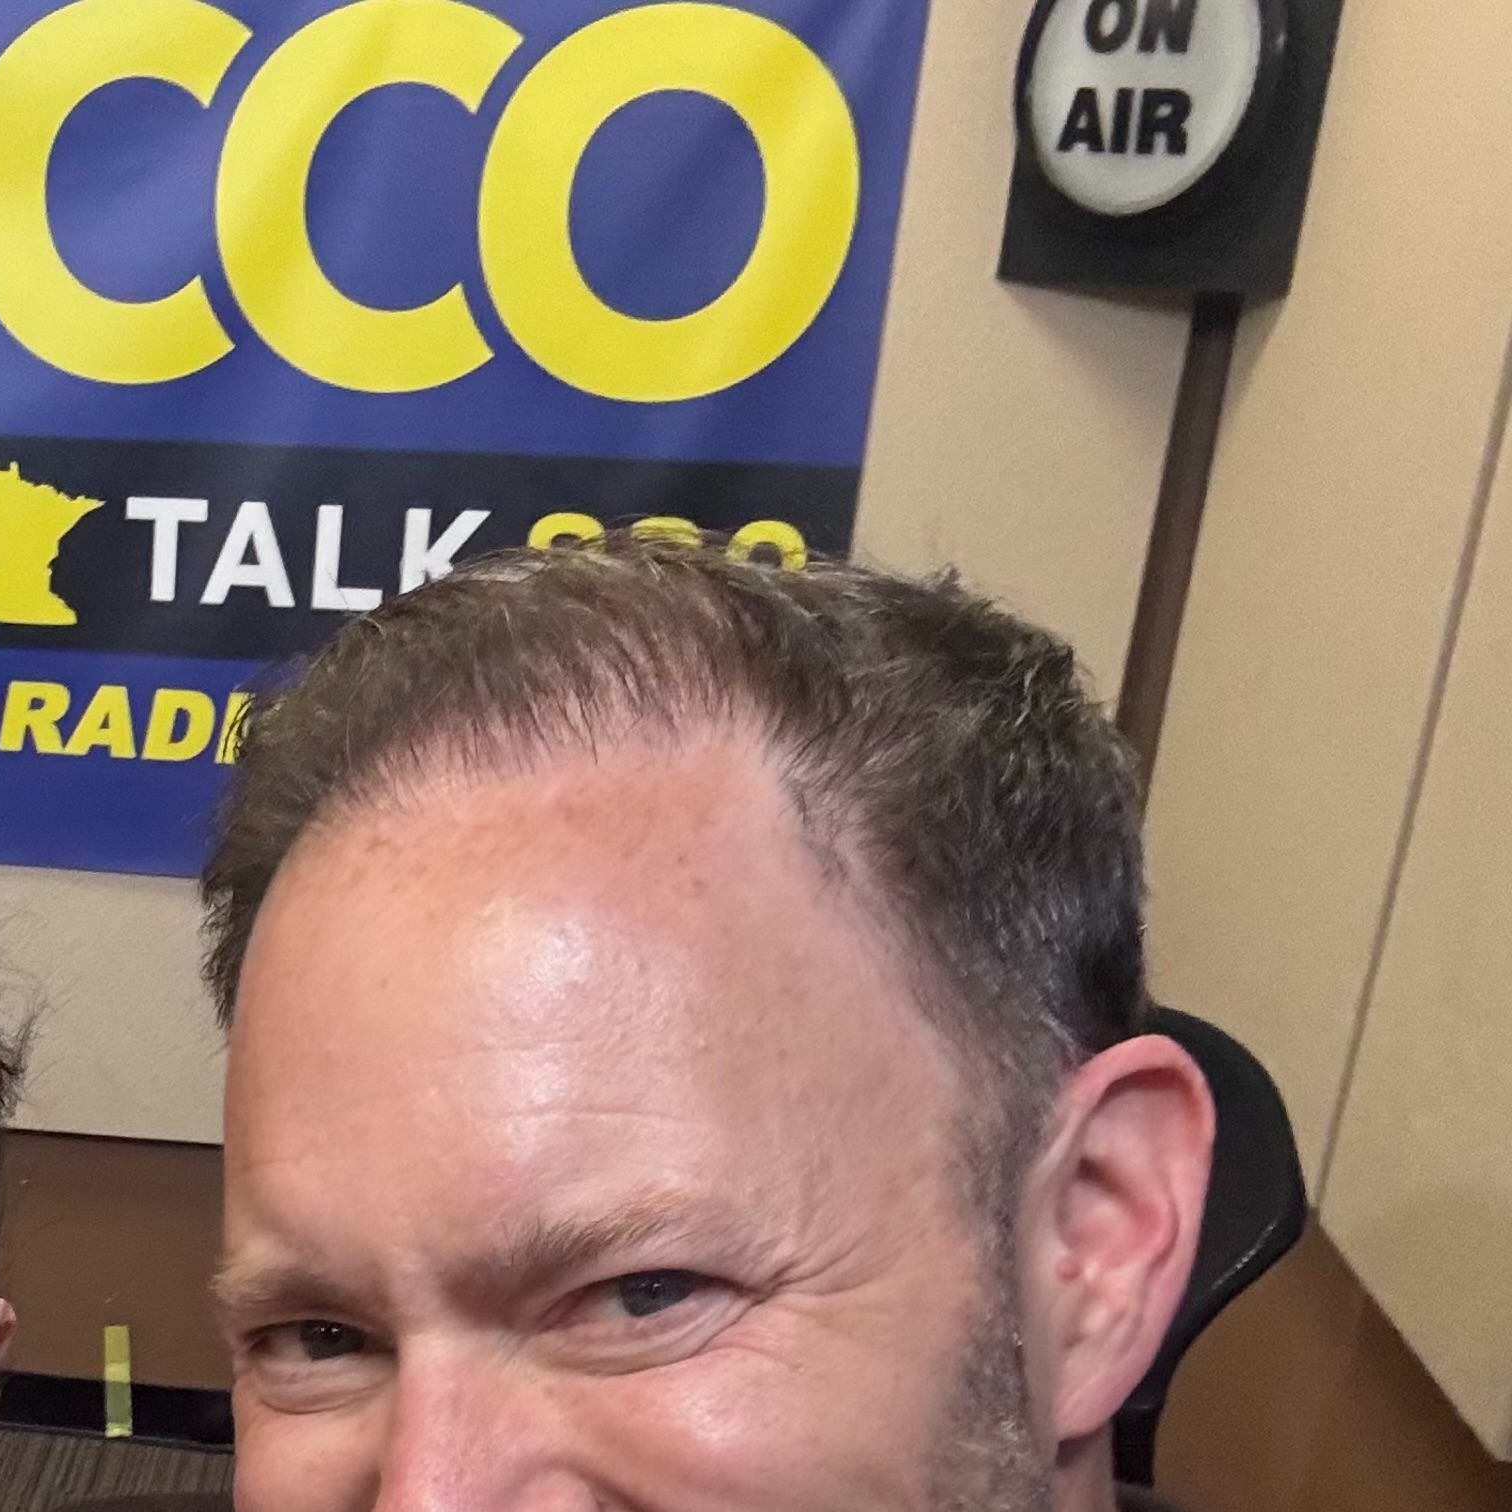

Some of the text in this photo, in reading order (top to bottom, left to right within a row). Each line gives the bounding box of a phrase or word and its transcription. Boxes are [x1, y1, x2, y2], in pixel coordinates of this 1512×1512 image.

[1085, 0, 1195, 54] ON
[1056, 86, 1192, 156] AIR
[124, 496, 492, 613] TALK
